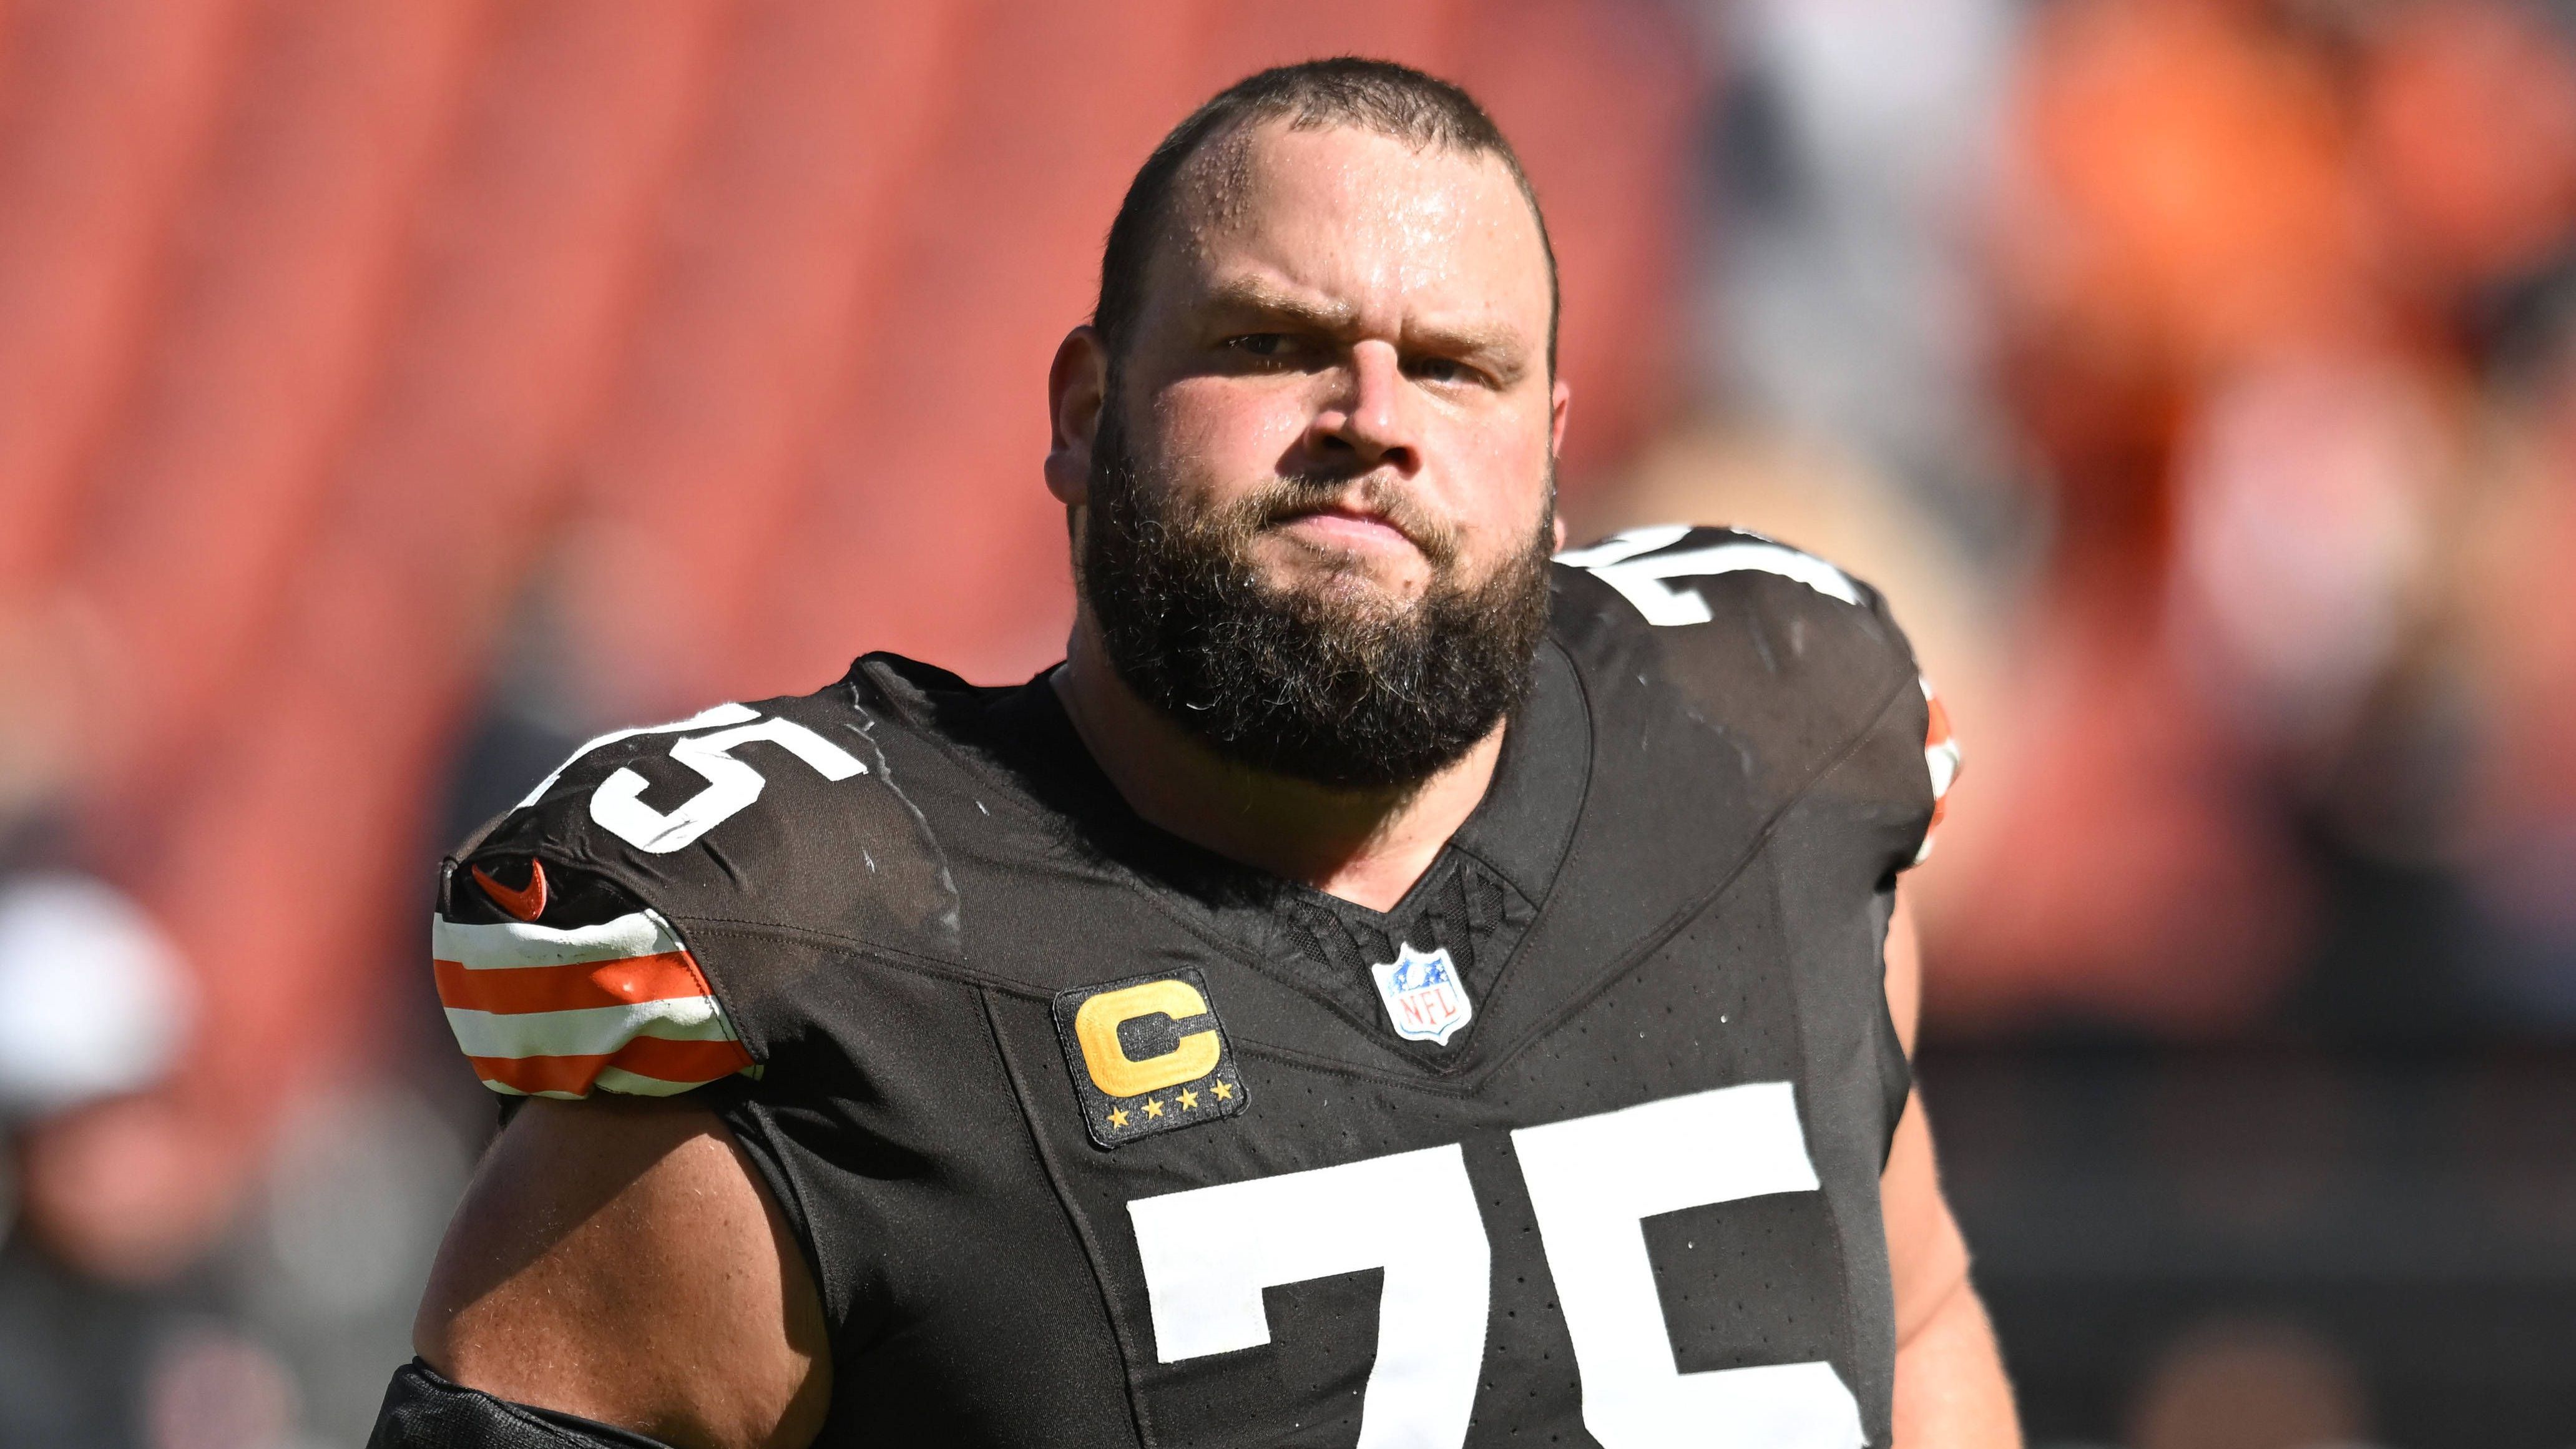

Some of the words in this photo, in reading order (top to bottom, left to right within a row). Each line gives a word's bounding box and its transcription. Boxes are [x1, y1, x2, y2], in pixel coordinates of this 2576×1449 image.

[1550, 524, 1864, 626] 7
[1075, 980, 1220, 1097] C
[1399, 988, 1456, 1025] NFL
[1127, 1082, 1869, 1449] 75
